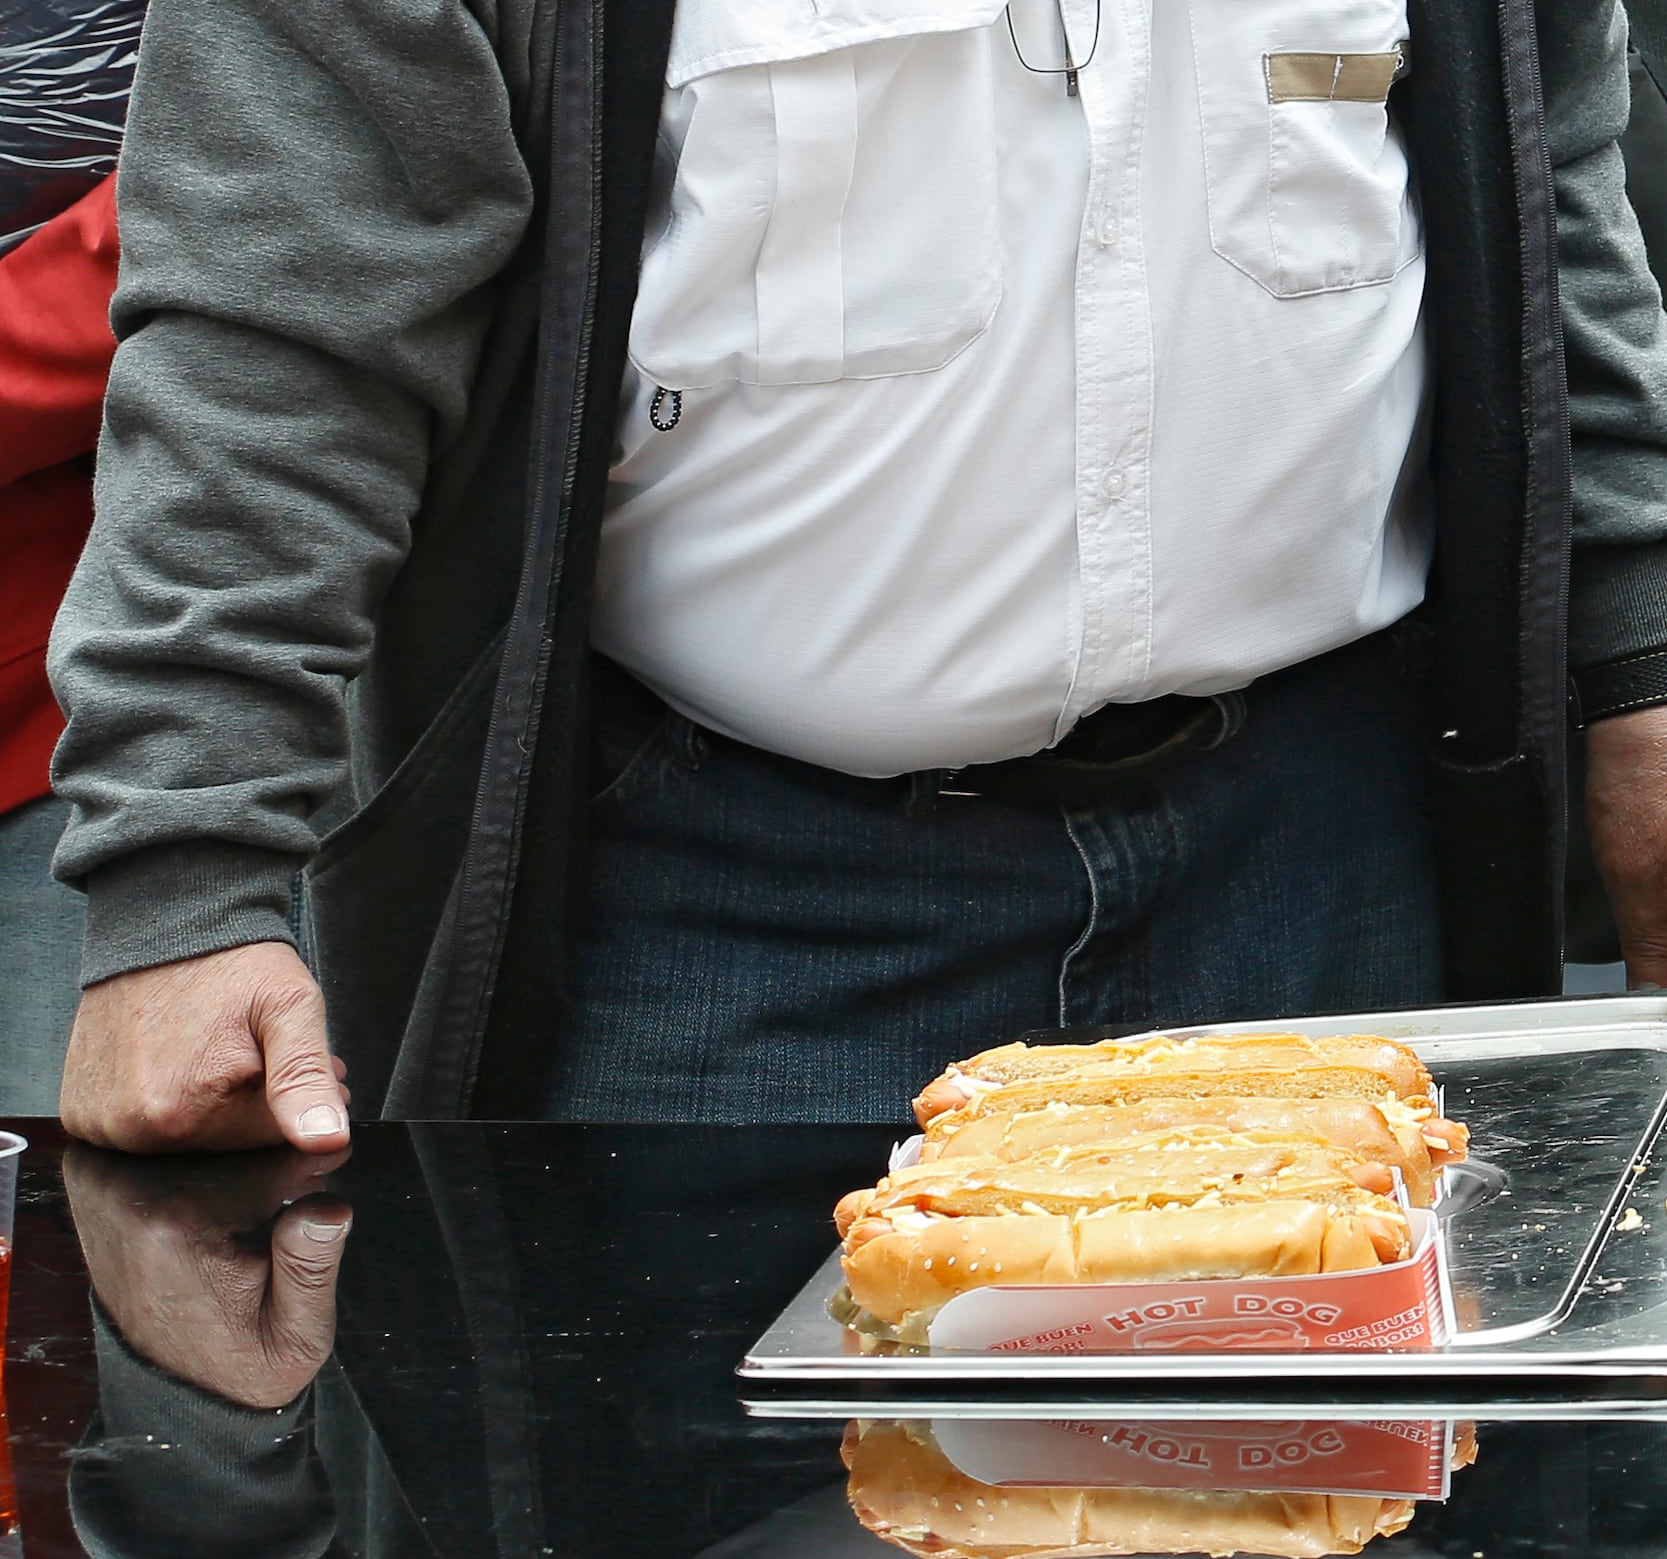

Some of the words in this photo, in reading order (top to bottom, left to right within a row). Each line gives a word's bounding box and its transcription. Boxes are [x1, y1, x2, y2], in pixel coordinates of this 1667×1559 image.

[1105, 1296, 1206, 1332] HOT
[1235, 1295, 1342, 1327] DOG
[1324, 1325, 1371, 1346] QUE
[1371, 1301, 1426, 1334] BUEN
[1034, 1323, 1093, 1344] BUEN
